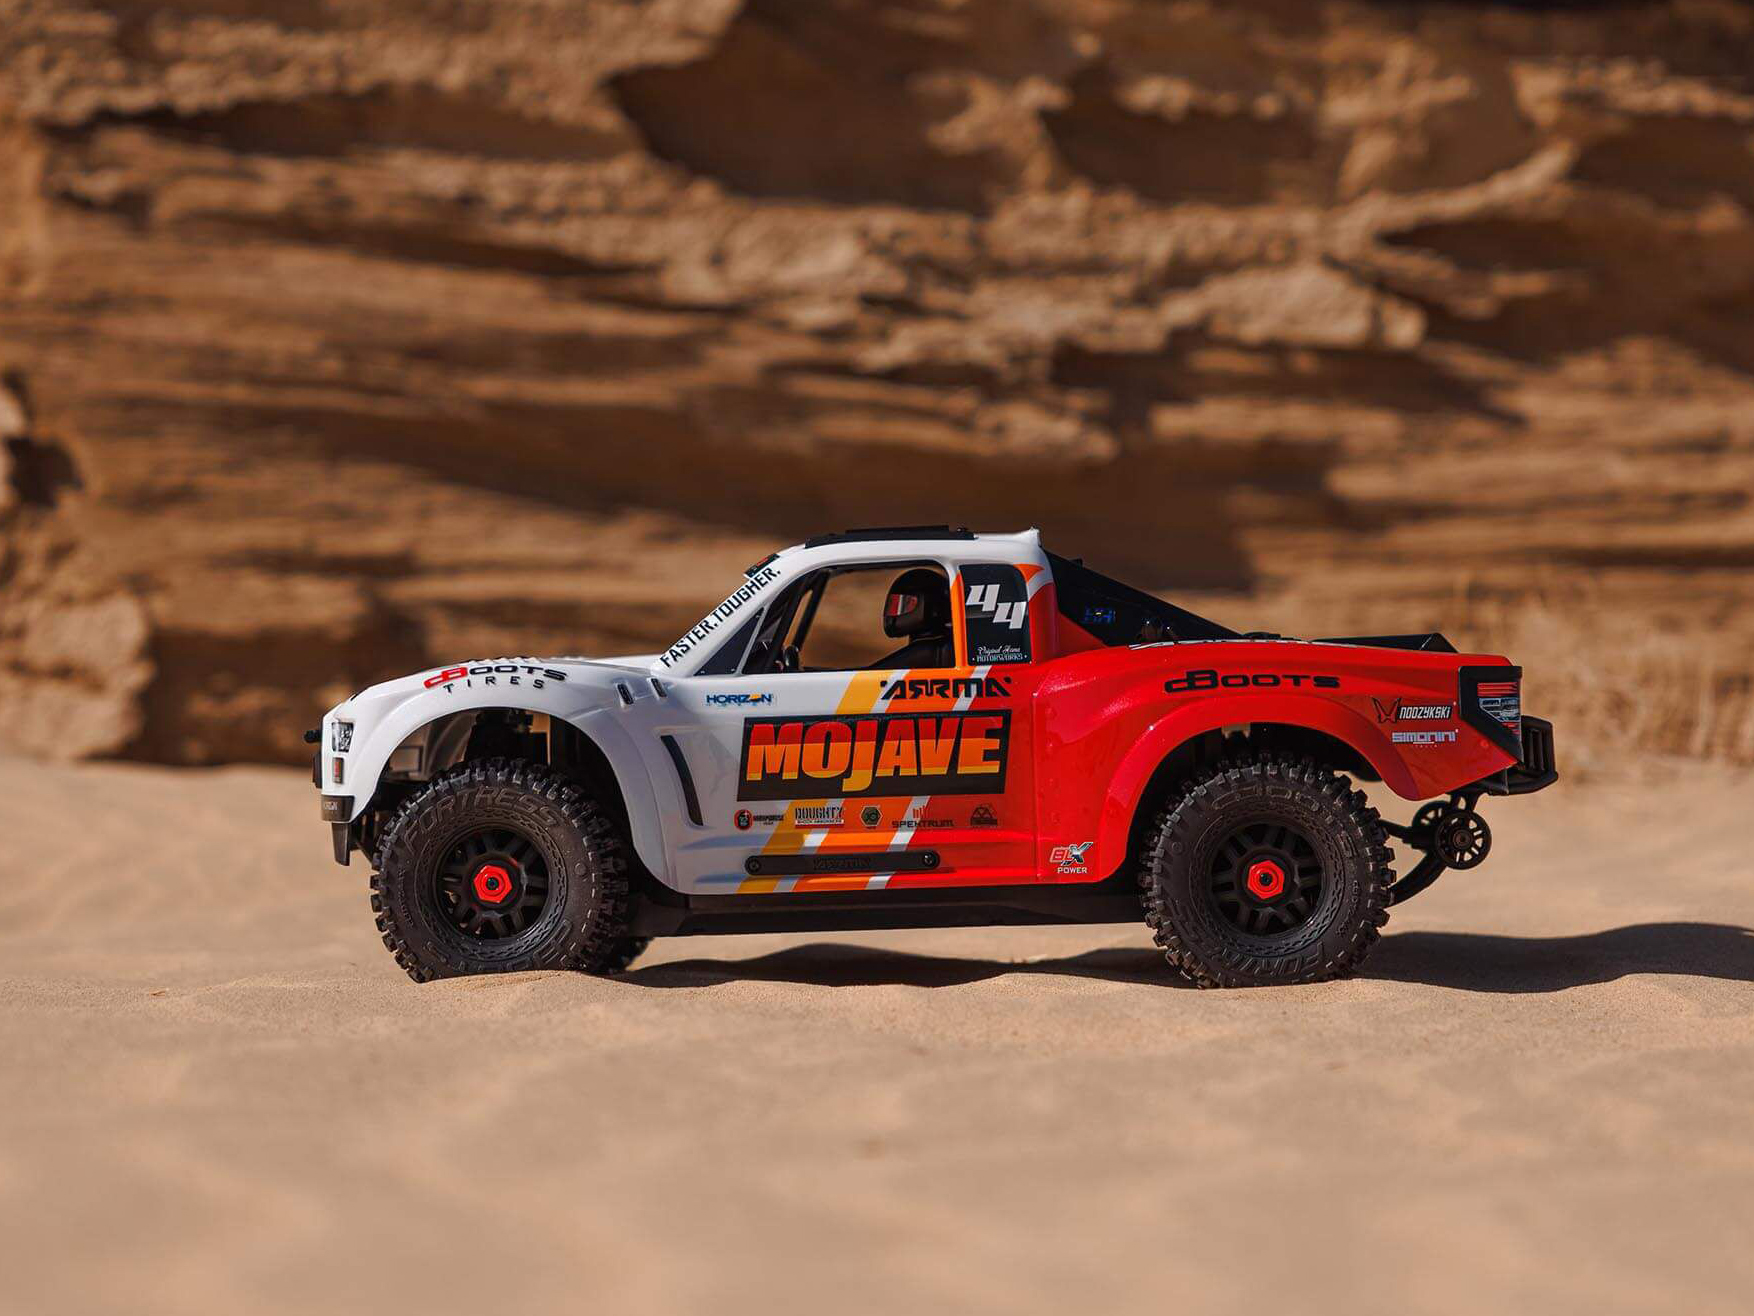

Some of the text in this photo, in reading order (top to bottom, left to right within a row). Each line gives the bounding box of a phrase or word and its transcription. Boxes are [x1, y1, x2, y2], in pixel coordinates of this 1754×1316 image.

[965, 584, 1027, 629] 44
[443, 676, 545, 694] TIRES
[746, 716, 1004, 792] MOJAVE
[404, 786, 564, 856] FORTRESS
[795, 806, 844, 819] DOUGHTY
[891, 820, 954, 828] SPEKTRUM
